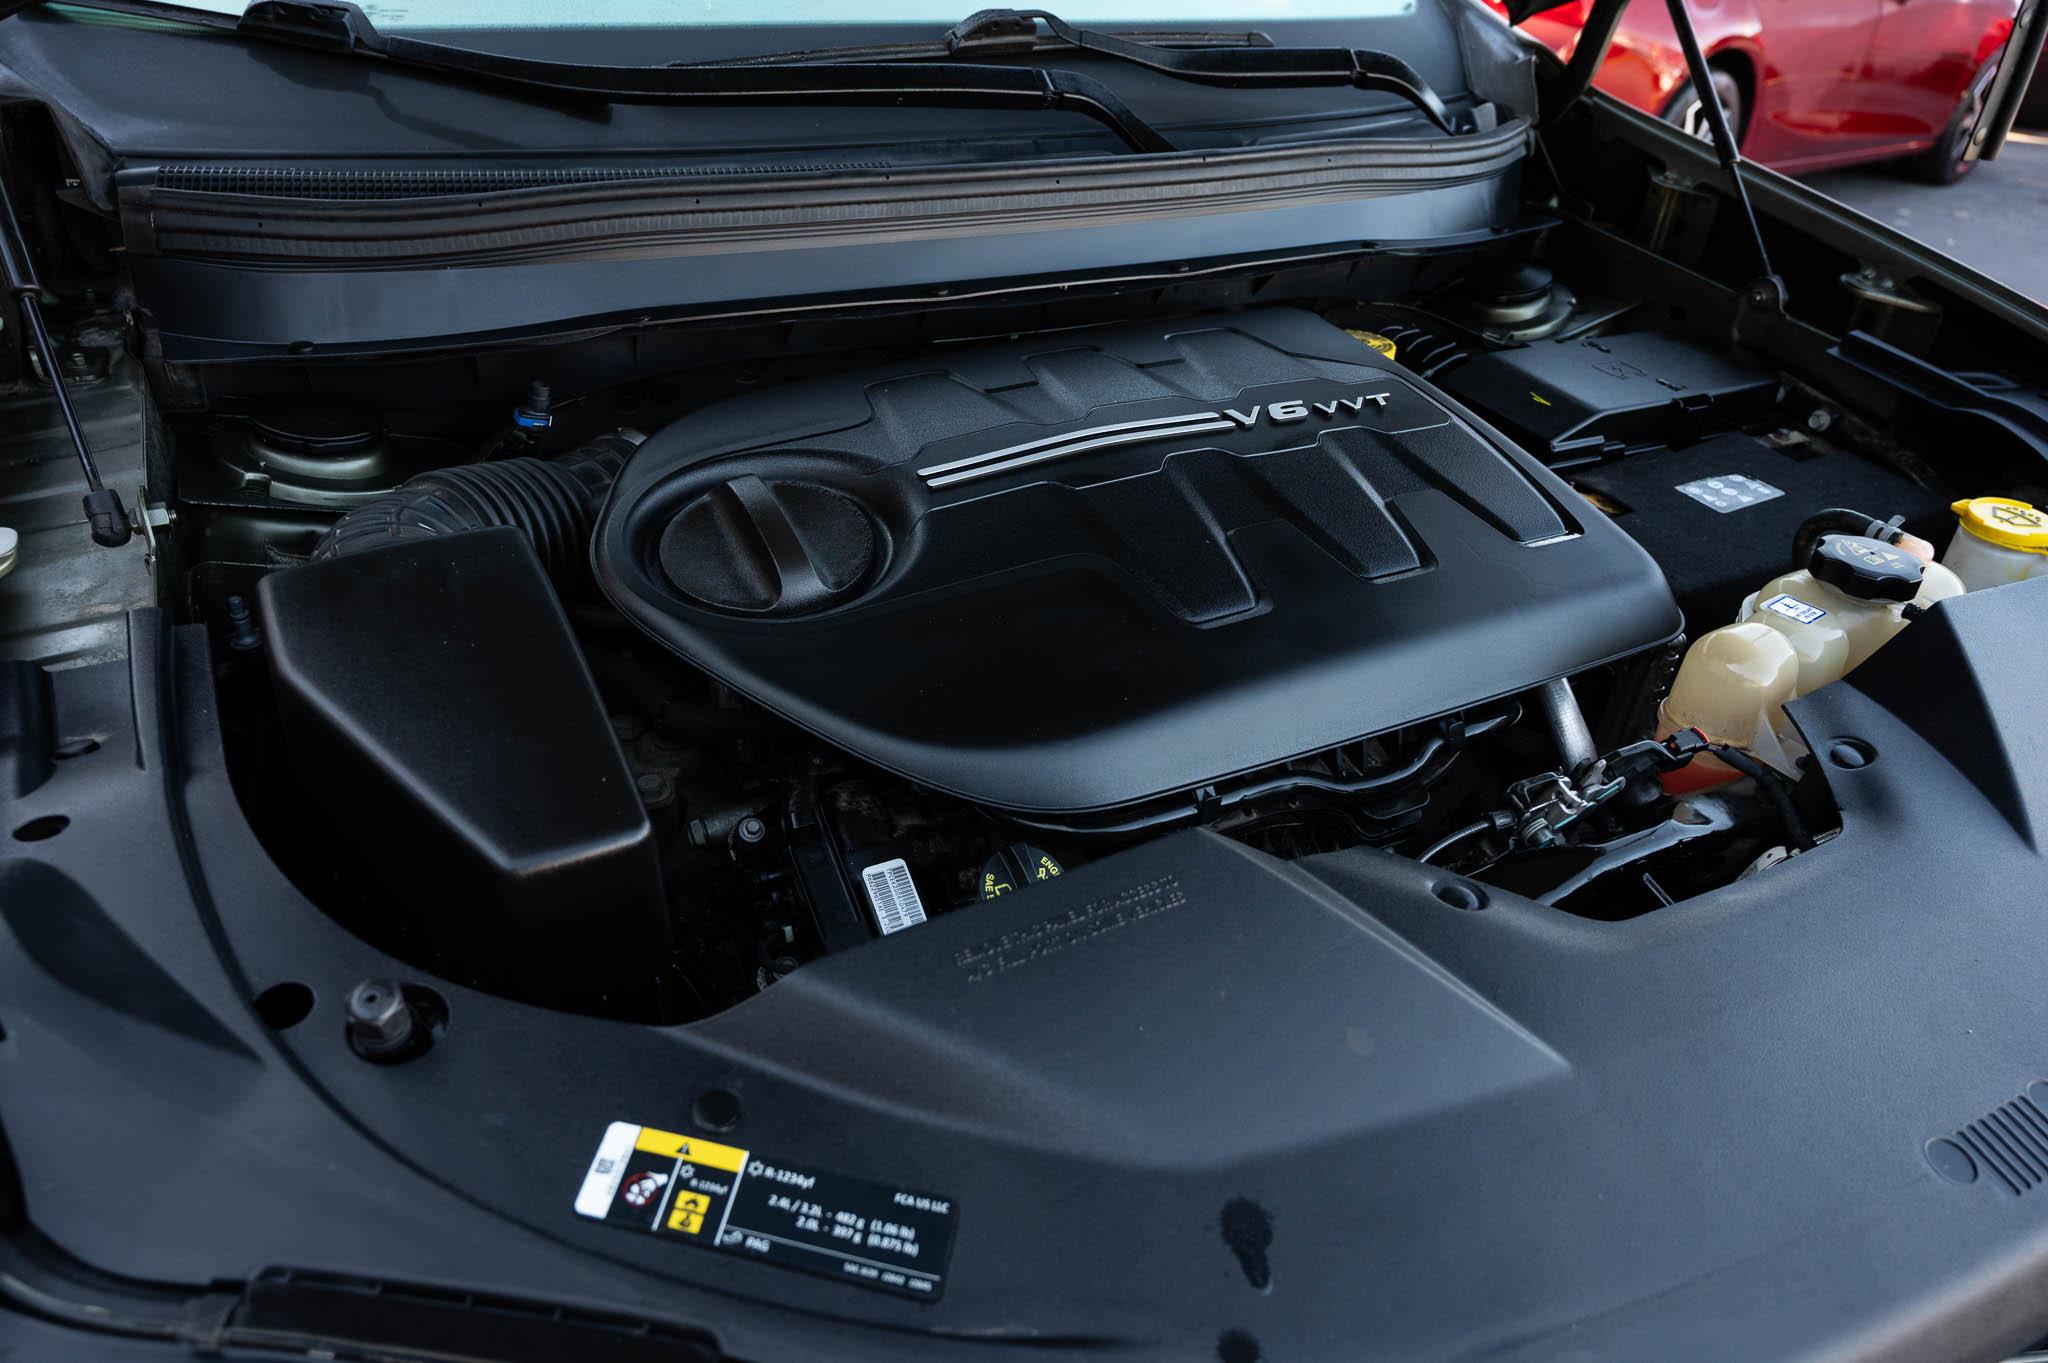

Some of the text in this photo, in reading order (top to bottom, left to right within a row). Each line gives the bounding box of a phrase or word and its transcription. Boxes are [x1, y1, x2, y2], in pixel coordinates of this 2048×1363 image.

[1222, 392, 1391, 428] V6 VVT
[985, 873, 995, 892] SAE
[894, 1192, 951, 1214] FCA US LLC
